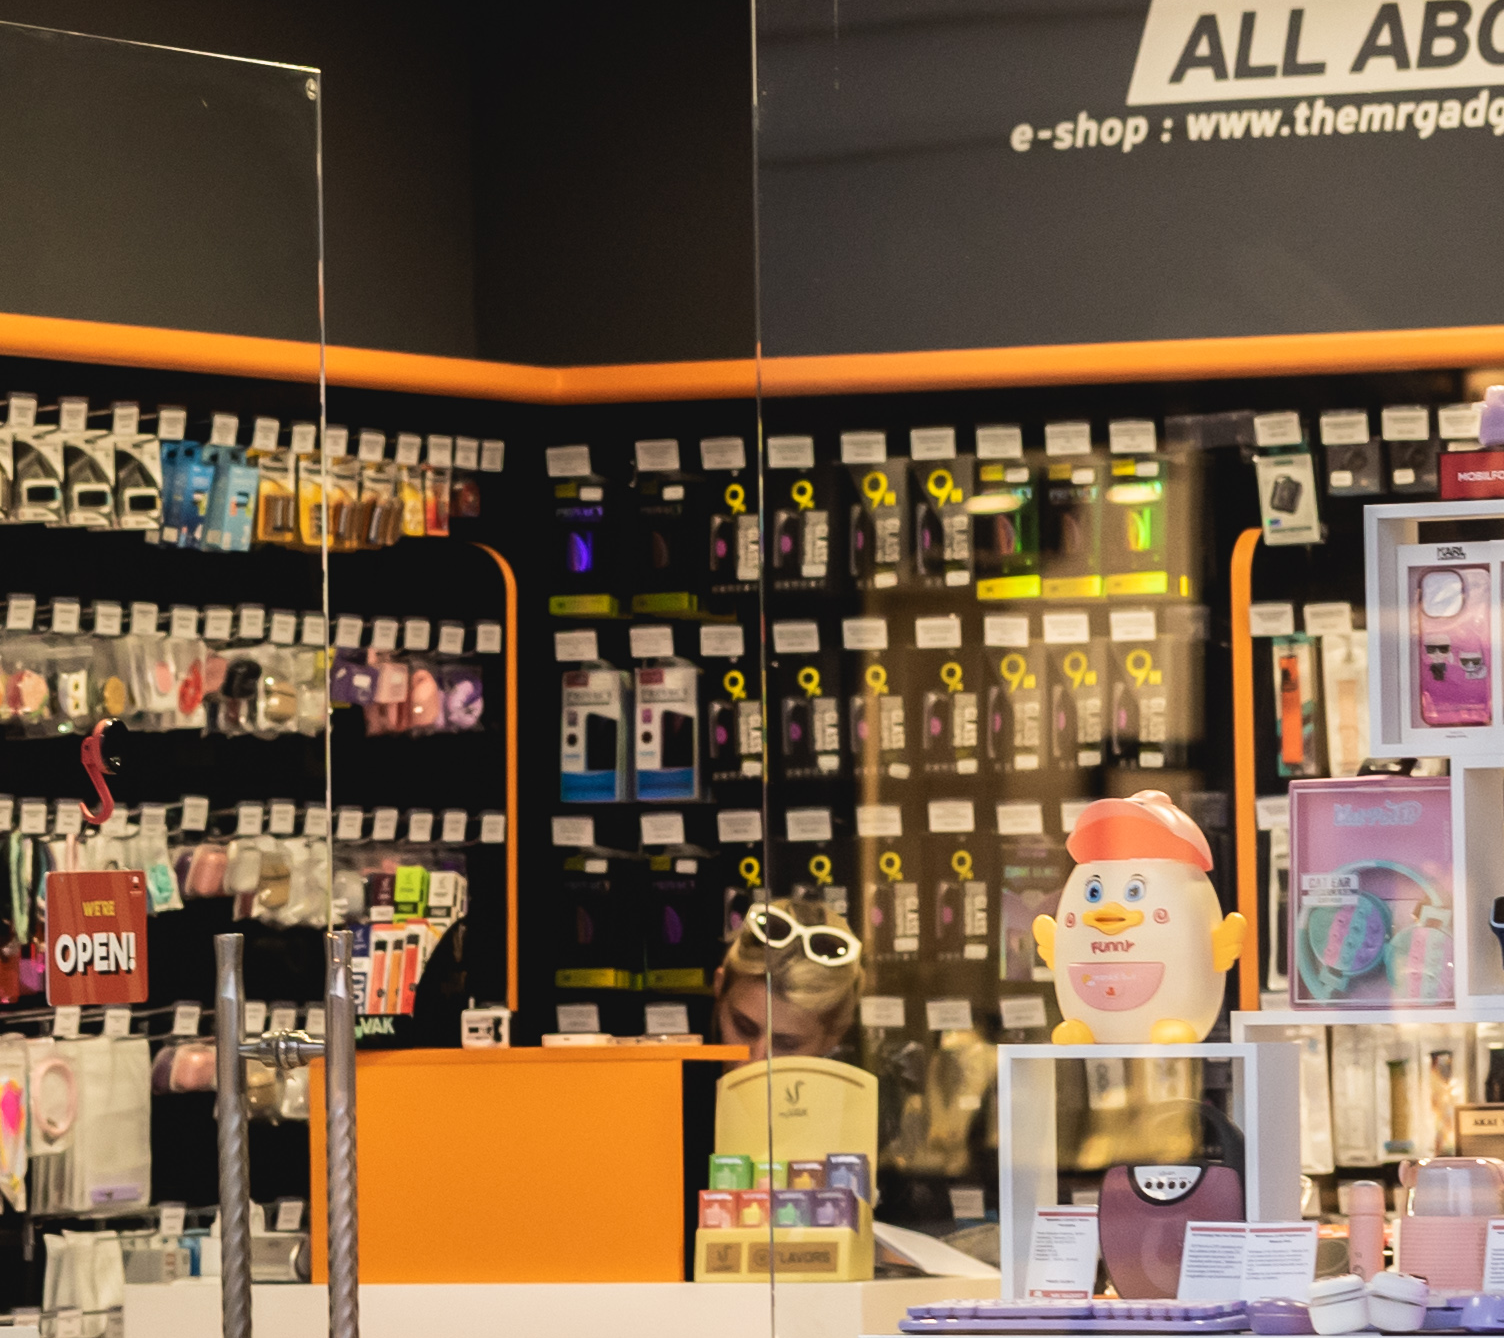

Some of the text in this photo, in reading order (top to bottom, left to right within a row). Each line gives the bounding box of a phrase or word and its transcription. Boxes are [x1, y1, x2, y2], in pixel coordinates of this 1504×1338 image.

[1169, 7, 1327, 85] ALL
[1010, 111, 1149, 154] e-shop
[82, 900, 116, 917] WE'RE
[54, 931, 137, 974] OPEN!
